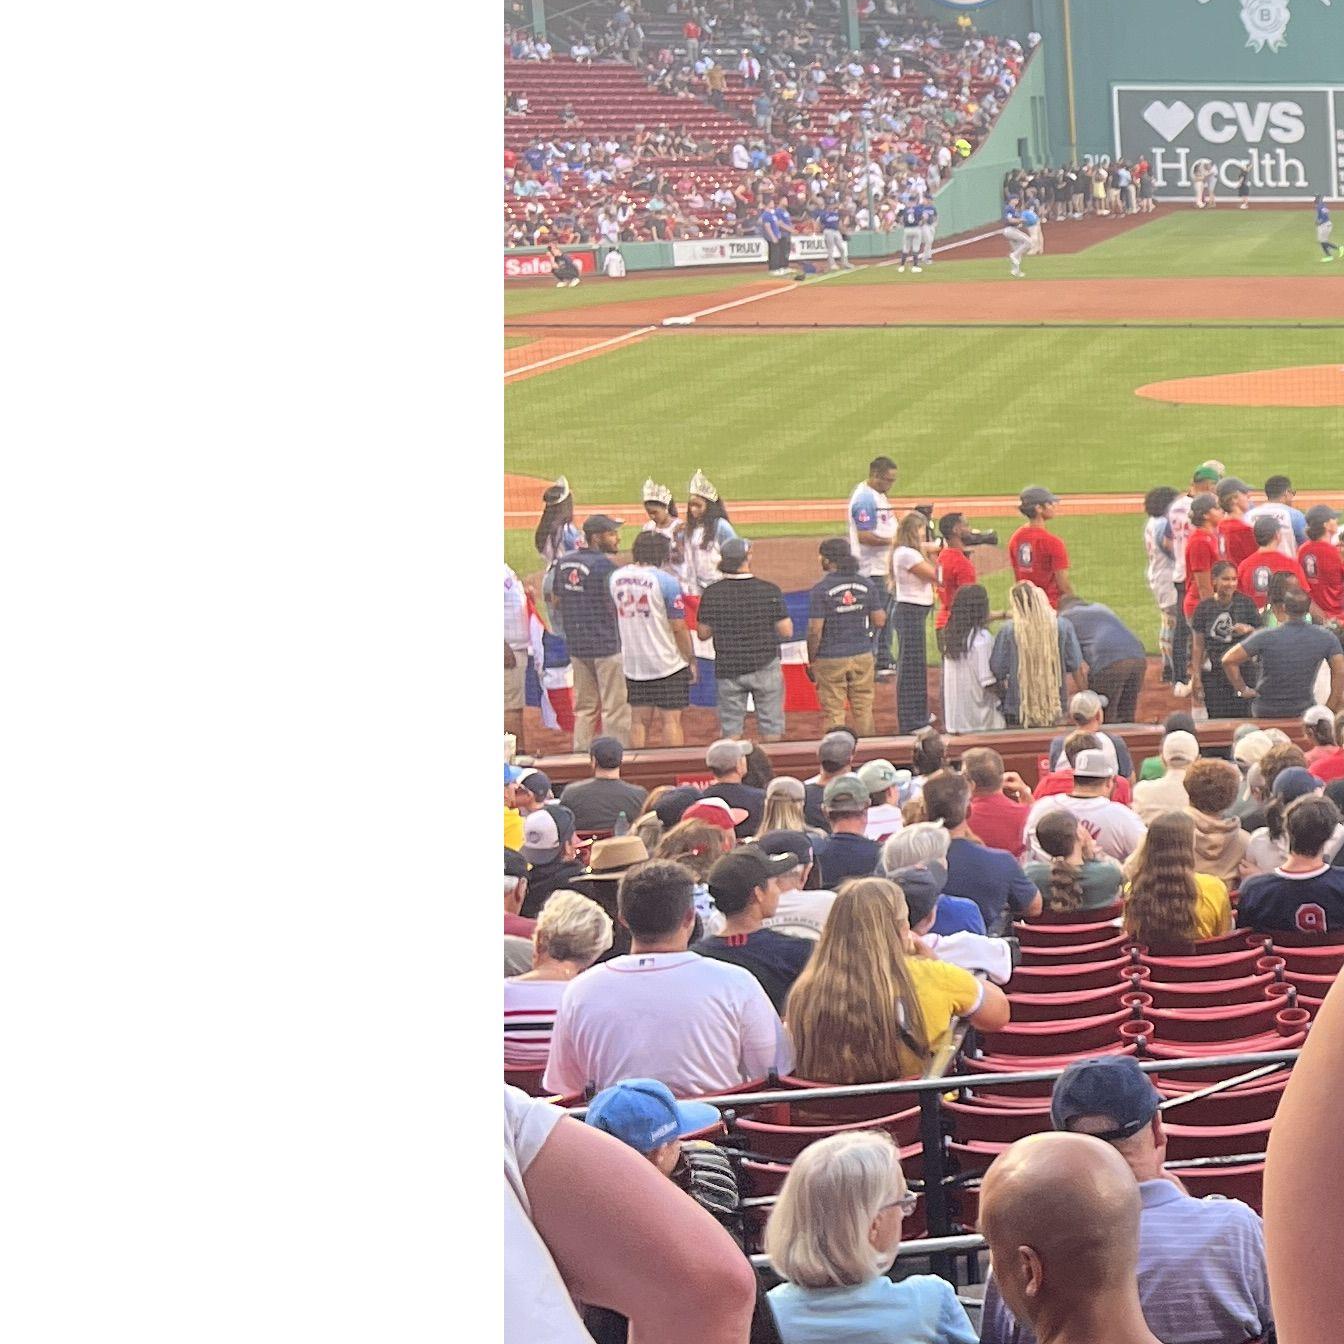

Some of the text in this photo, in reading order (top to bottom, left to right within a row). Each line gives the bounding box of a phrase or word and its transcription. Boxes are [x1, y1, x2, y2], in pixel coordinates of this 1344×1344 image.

[1259, 7, 1271, 22] B
[1197, 100, 1306, 144] CVS
[729, 242, 762, 254] TRULY
[800, 239, 826, 251] TRUL
